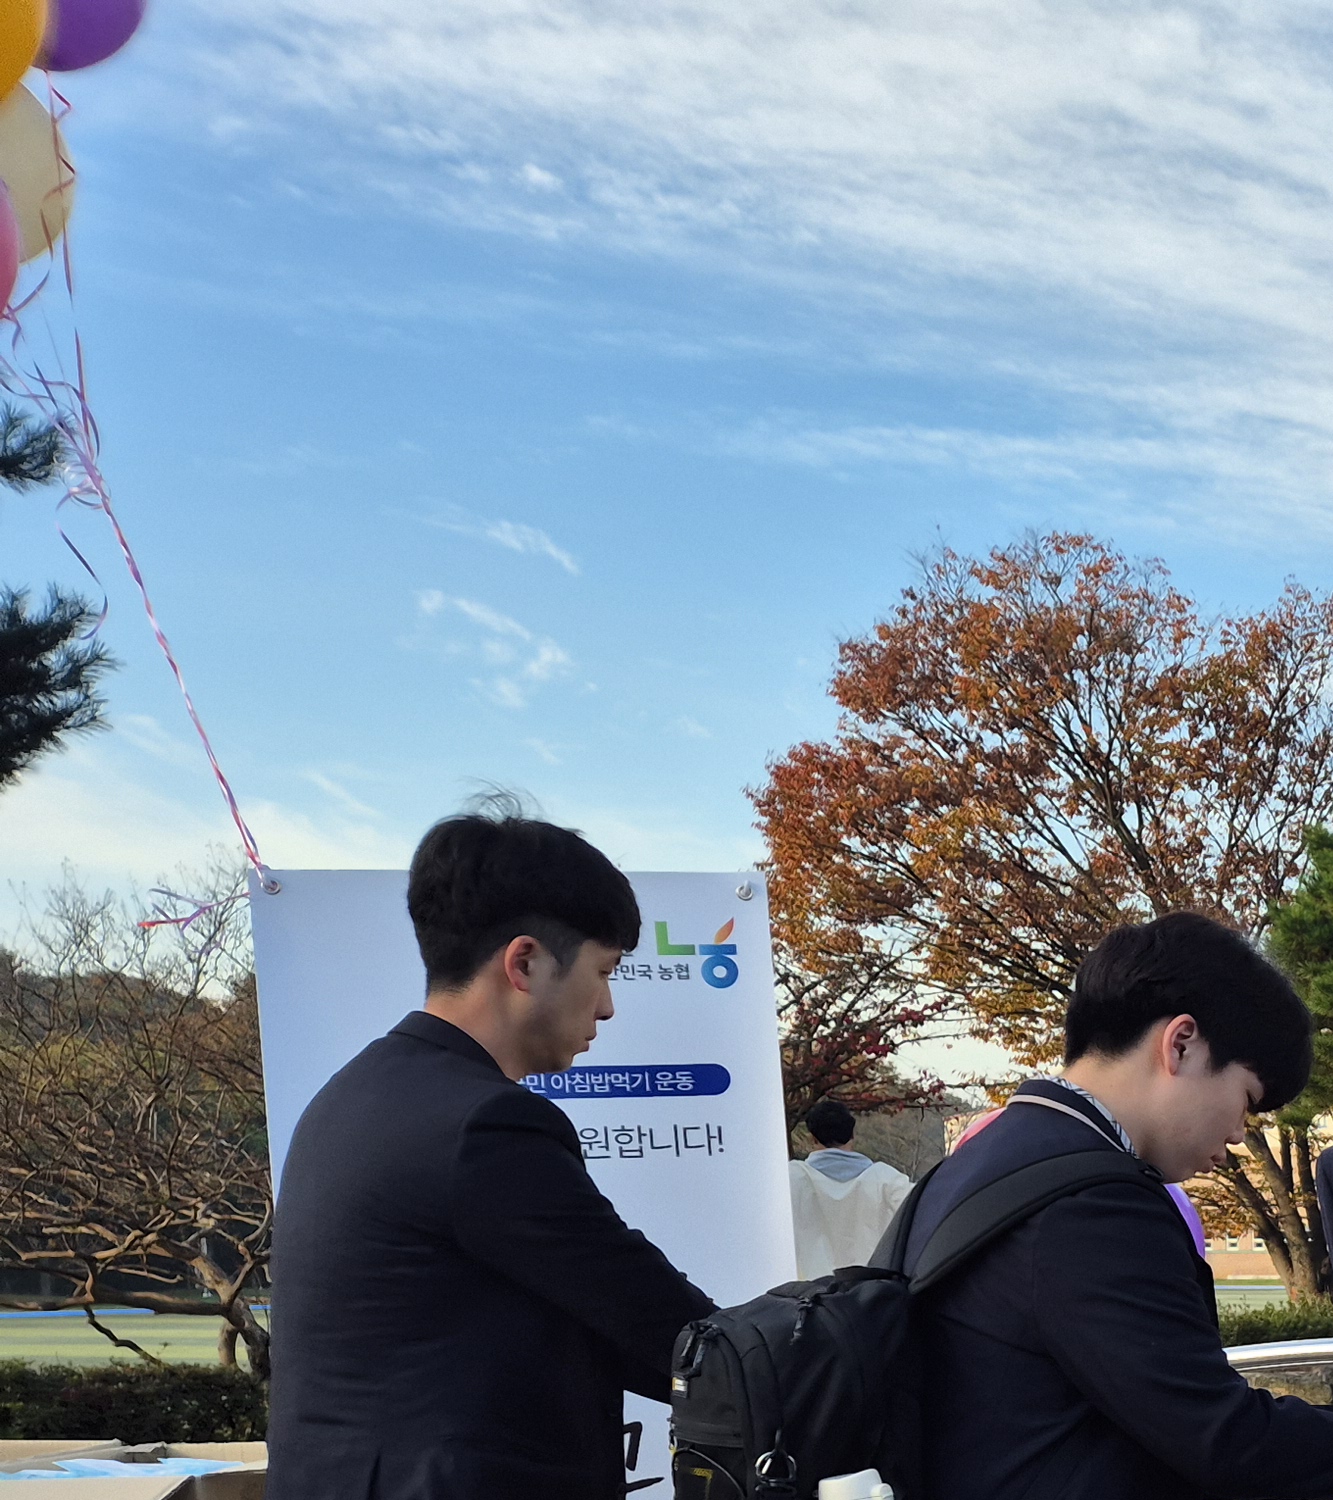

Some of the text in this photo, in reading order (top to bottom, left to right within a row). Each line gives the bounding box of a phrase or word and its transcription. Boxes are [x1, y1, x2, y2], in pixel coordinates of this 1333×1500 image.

[657, 963, 690, 981] 농협
[551, 1070, 651, 1094] 아침밥먹기
[655, 1070, 695, 1092] 운동
